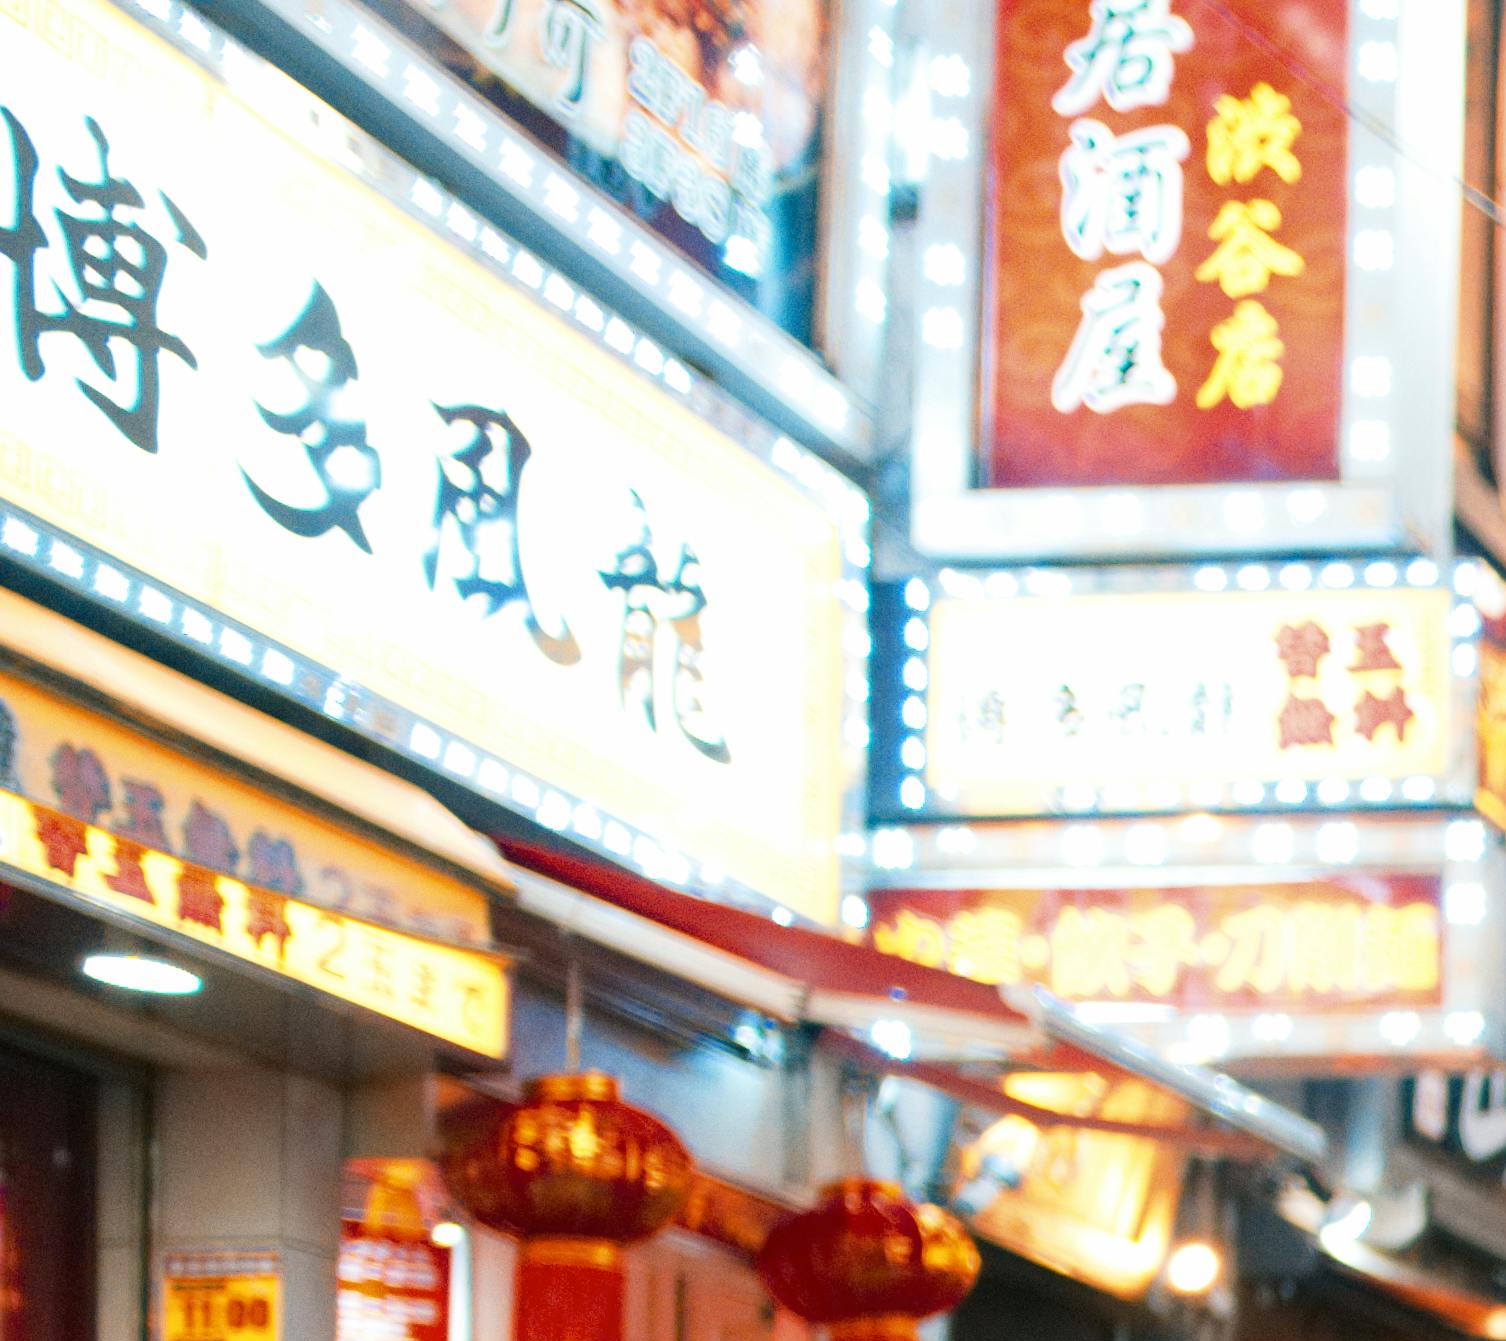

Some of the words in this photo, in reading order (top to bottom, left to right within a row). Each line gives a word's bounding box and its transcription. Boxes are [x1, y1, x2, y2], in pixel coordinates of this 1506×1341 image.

[1052, 0, 1194, 414] 居酒屋
[1196, 82, 1306, 411] 渋谷店
[0, 103, 734, 766] 博多風龍
